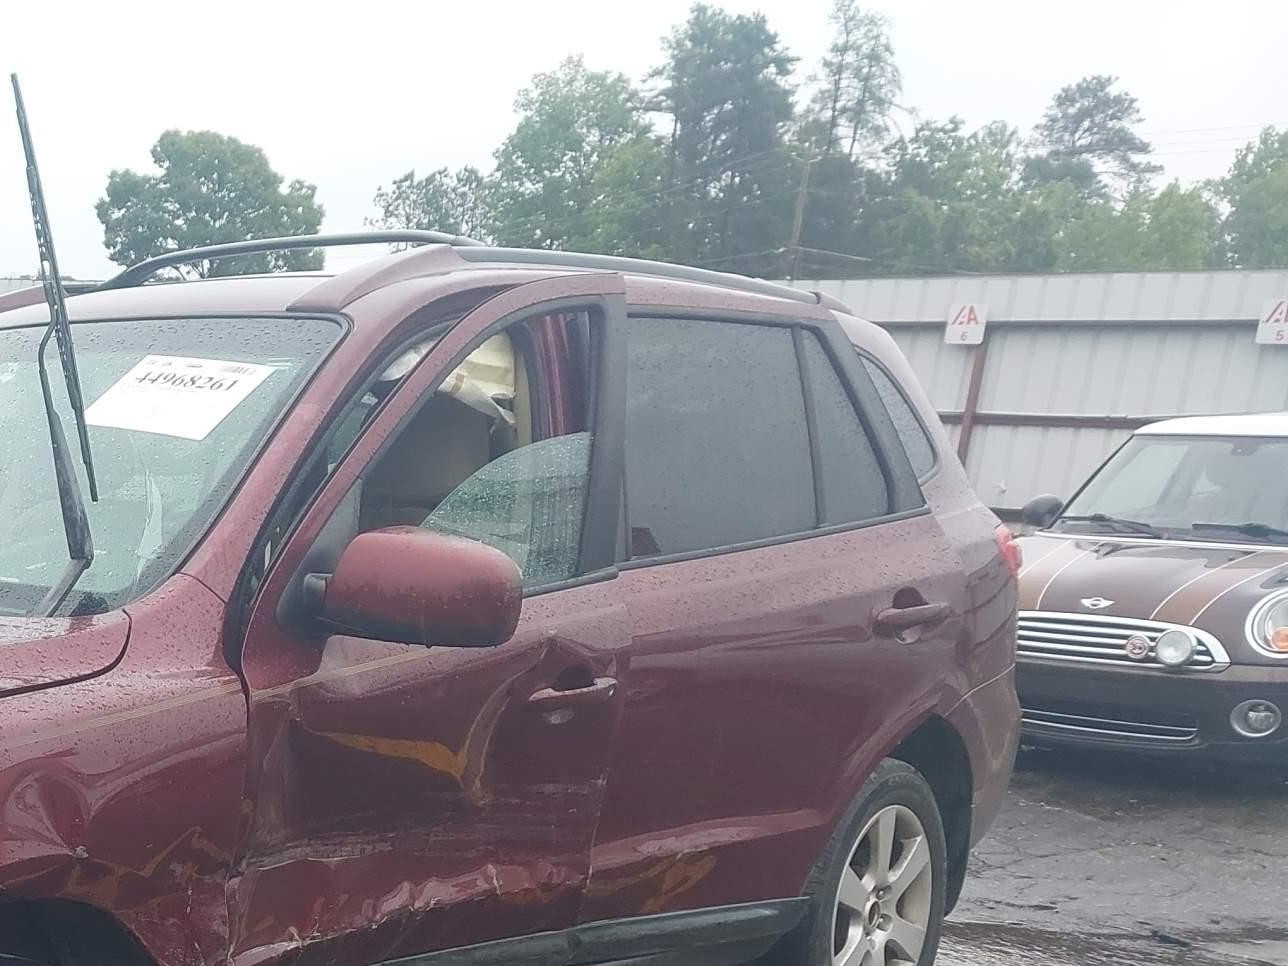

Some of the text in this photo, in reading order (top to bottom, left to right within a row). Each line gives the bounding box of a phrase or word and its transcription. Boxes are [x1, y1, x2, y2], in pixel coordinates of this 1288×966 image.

[960, 331, 968, 341] 6
[1276, 330, 1284, 341] 5
[136, 371, 239, 391] 44968261
